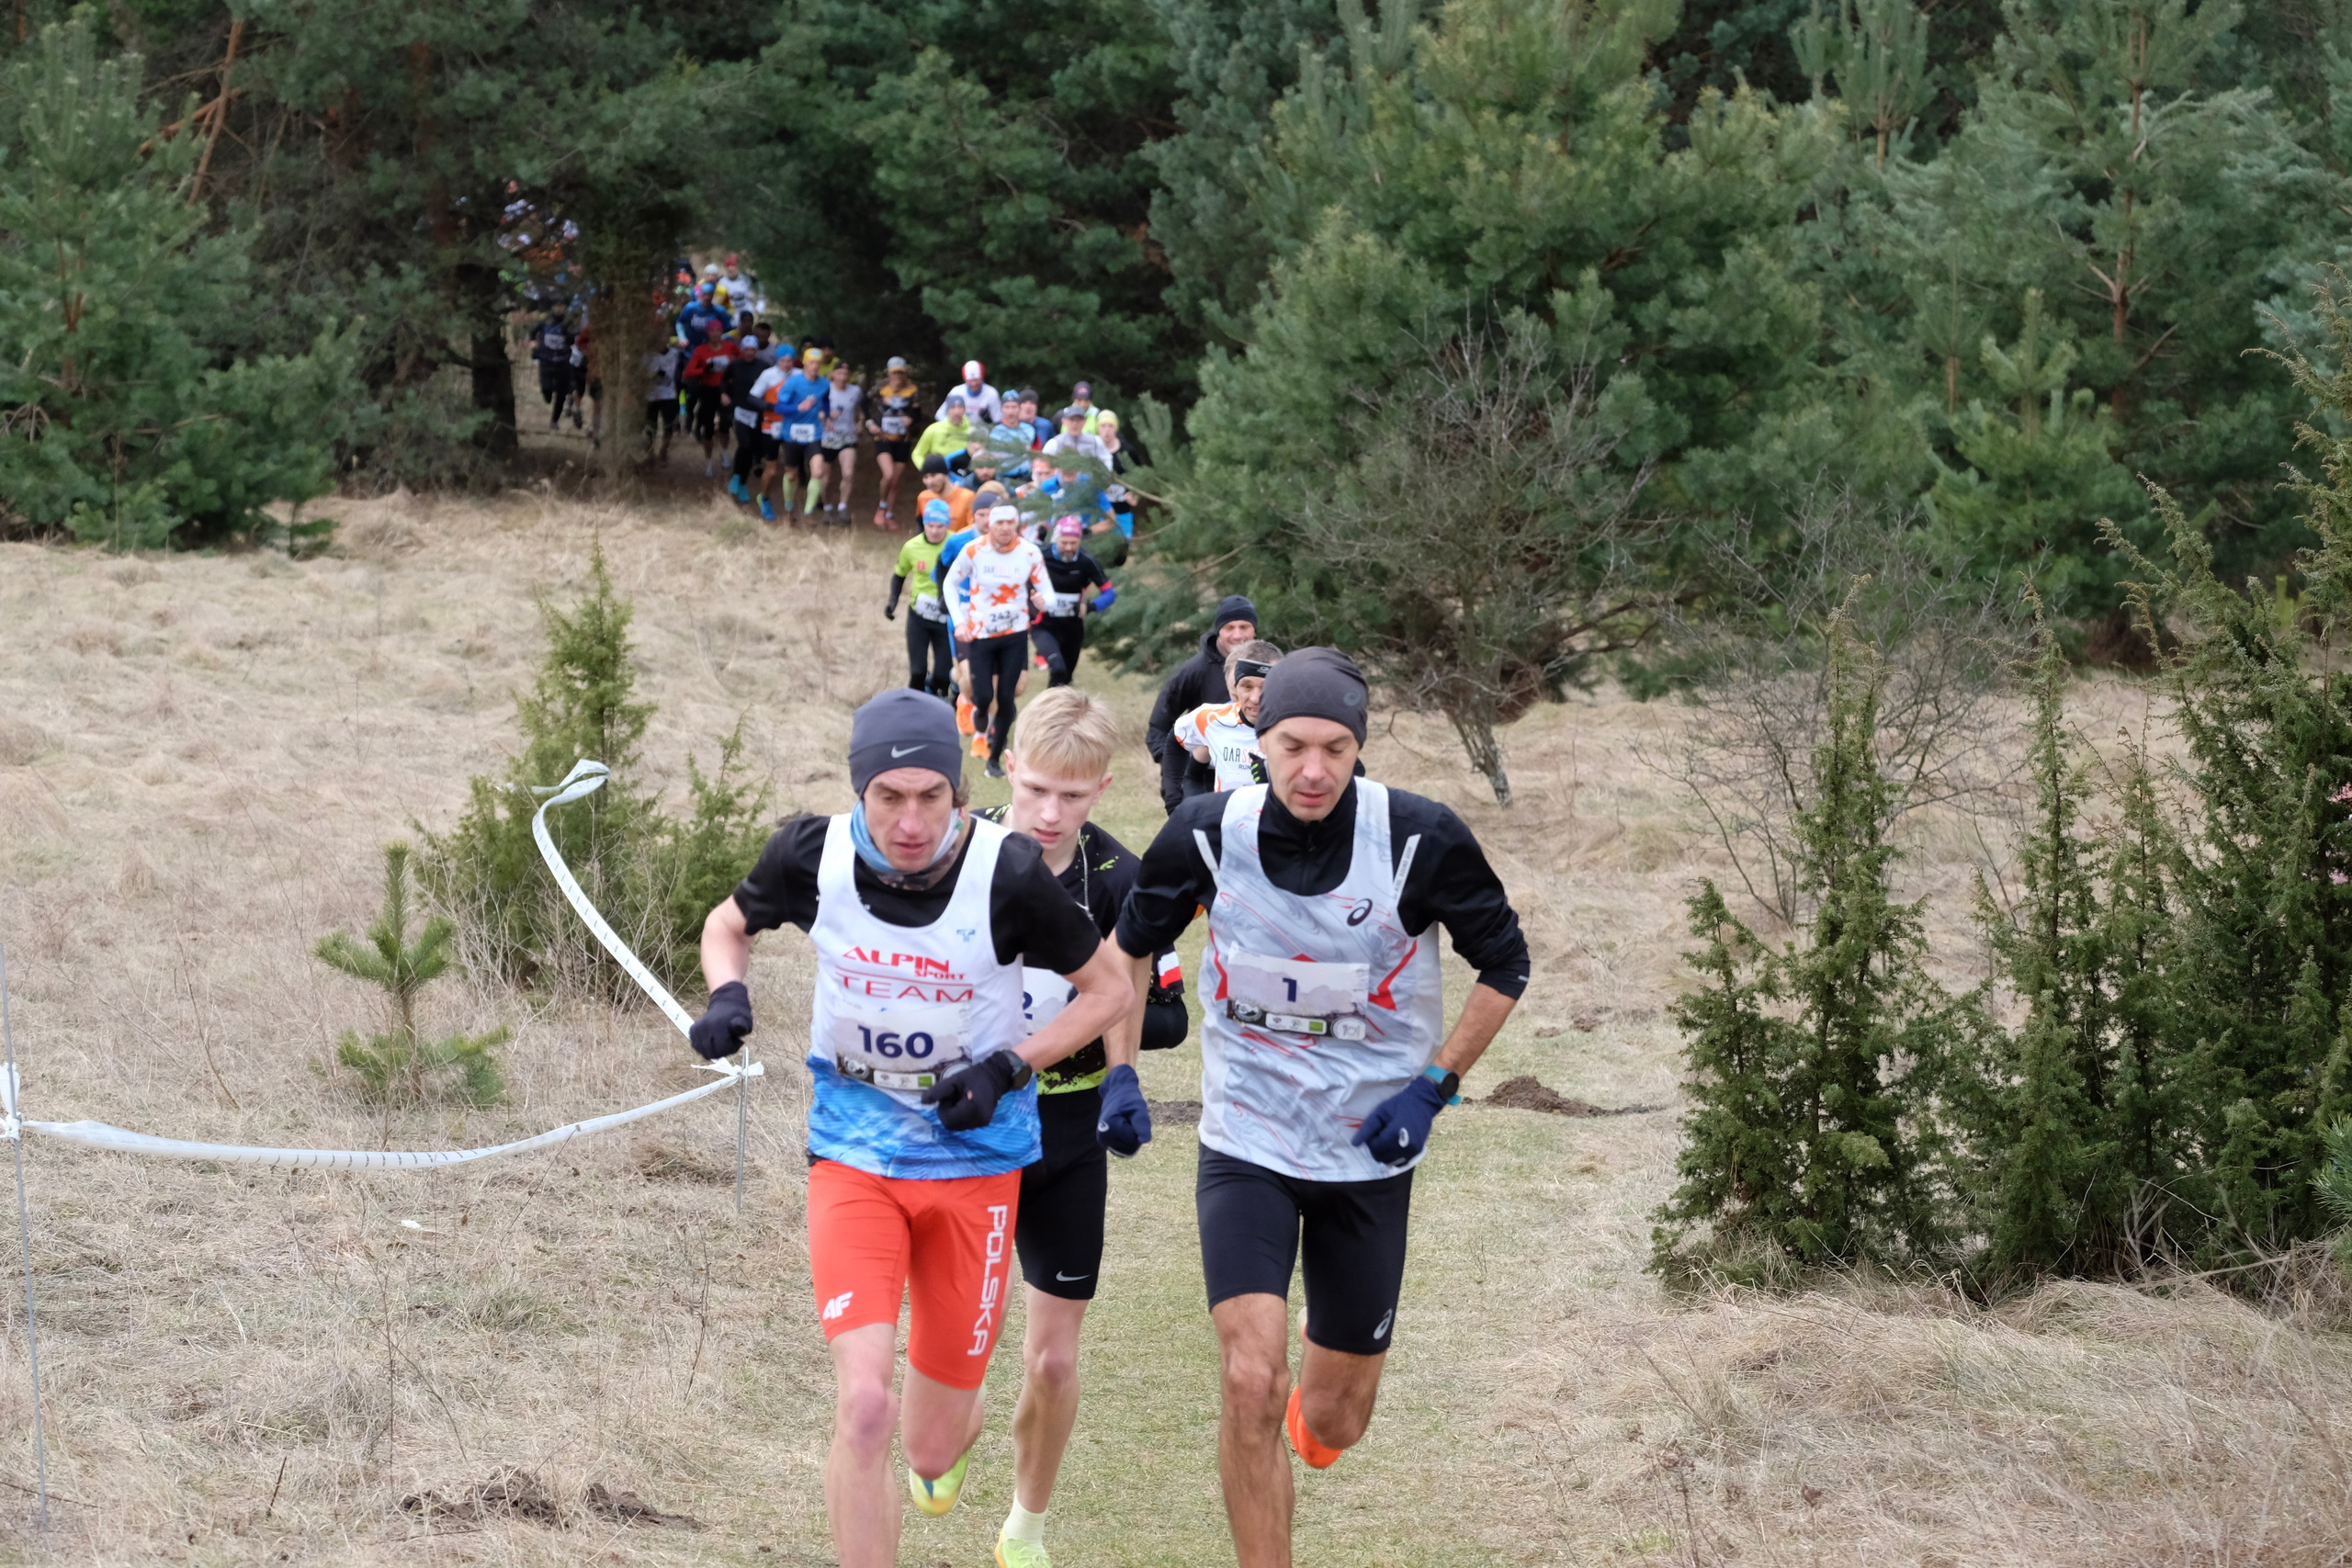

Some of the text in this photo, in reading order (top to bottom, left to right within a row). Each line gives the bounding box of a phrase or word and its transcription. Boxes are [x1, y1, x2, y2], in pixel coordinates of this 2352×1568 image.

[842, 945, 949, 974] ALPIN
[835, 972, 973, 1003] TEAM
[914, 970, 965, 981] SPORT
[1283, 977, 1297, 1002] 1
[857, 1024, 934, 1059] 160
[967, 1204, 1009, 1357] POLSKA
